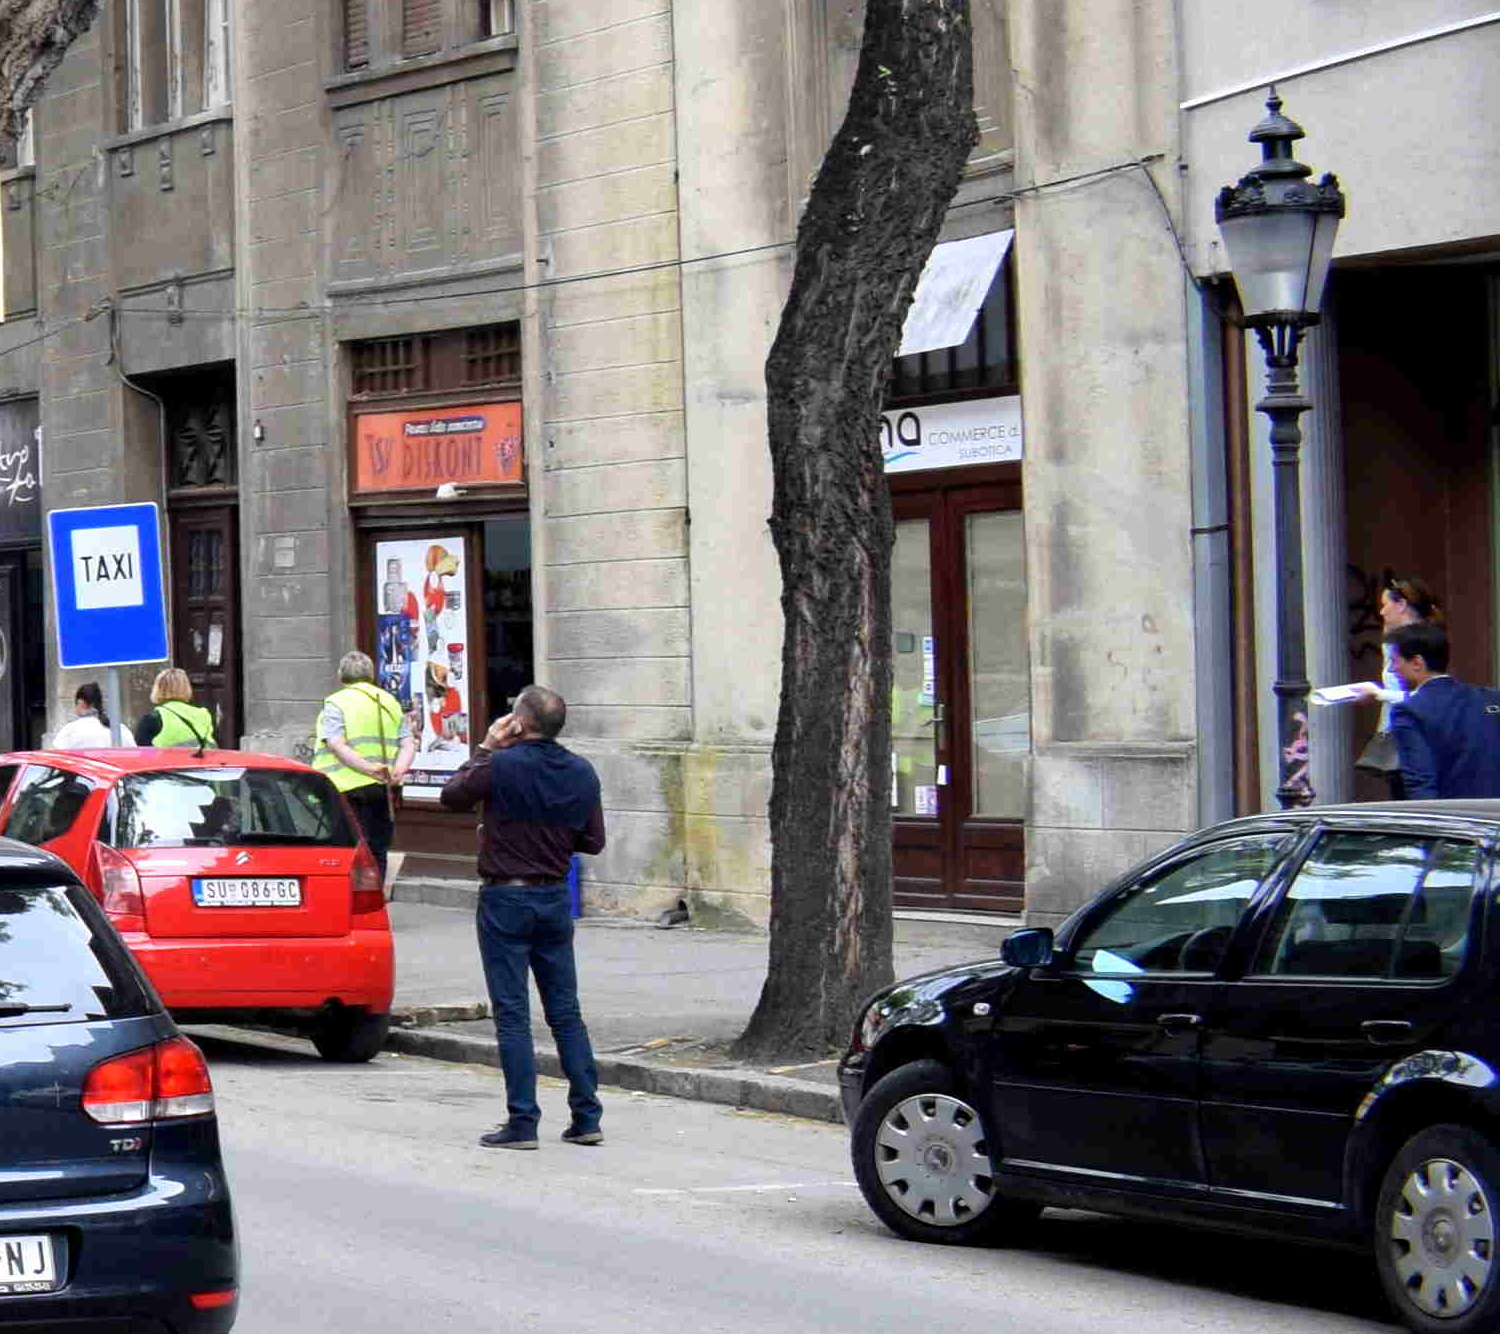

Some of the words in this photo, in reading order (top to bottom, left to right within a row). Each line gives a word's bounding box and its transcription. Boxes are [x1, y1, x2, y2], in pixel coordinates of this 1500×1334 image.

[928, 426, 1005, 446] COMMERCE
[403, 435, 483, 479] DISKONT
[78, 552, 134, 583] TAXI
[206, 881, 227, 899] SU
